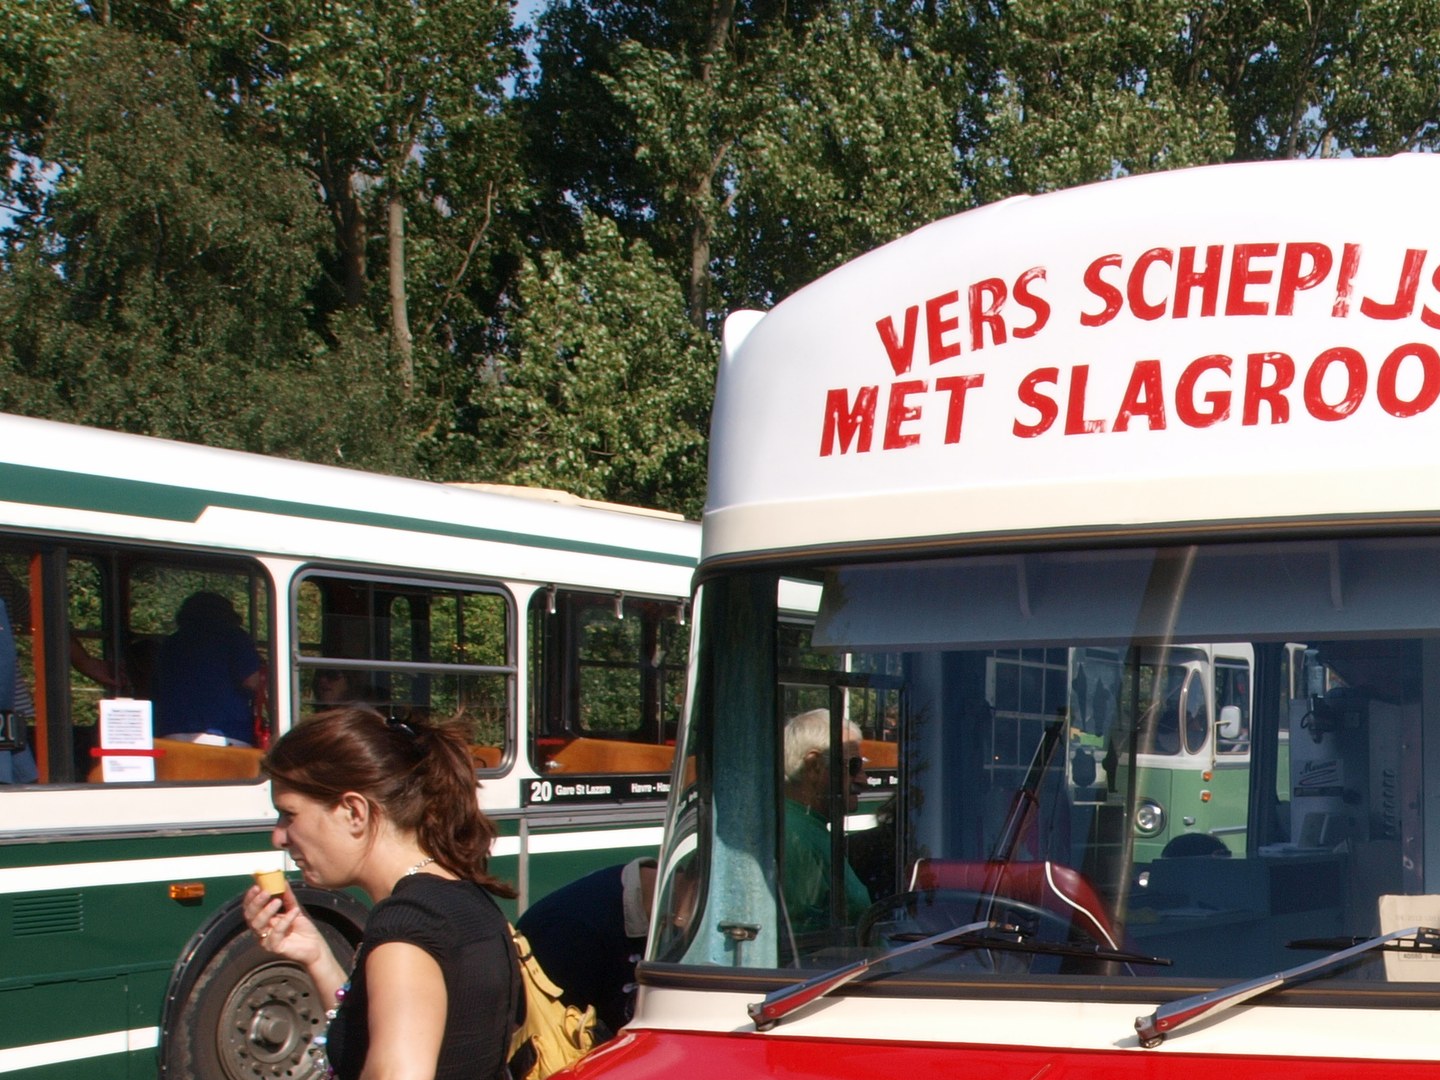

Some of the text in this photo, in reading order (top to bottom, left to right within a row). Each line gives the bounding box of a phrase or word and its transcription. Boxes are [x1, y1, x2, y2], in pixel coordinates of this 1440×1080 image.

[875, 267, 1052, 373] VERS
[820, 373, 984, 456] MET
[531, 781, 552, 802] 20
[555, 785, 575, 796] Gare
